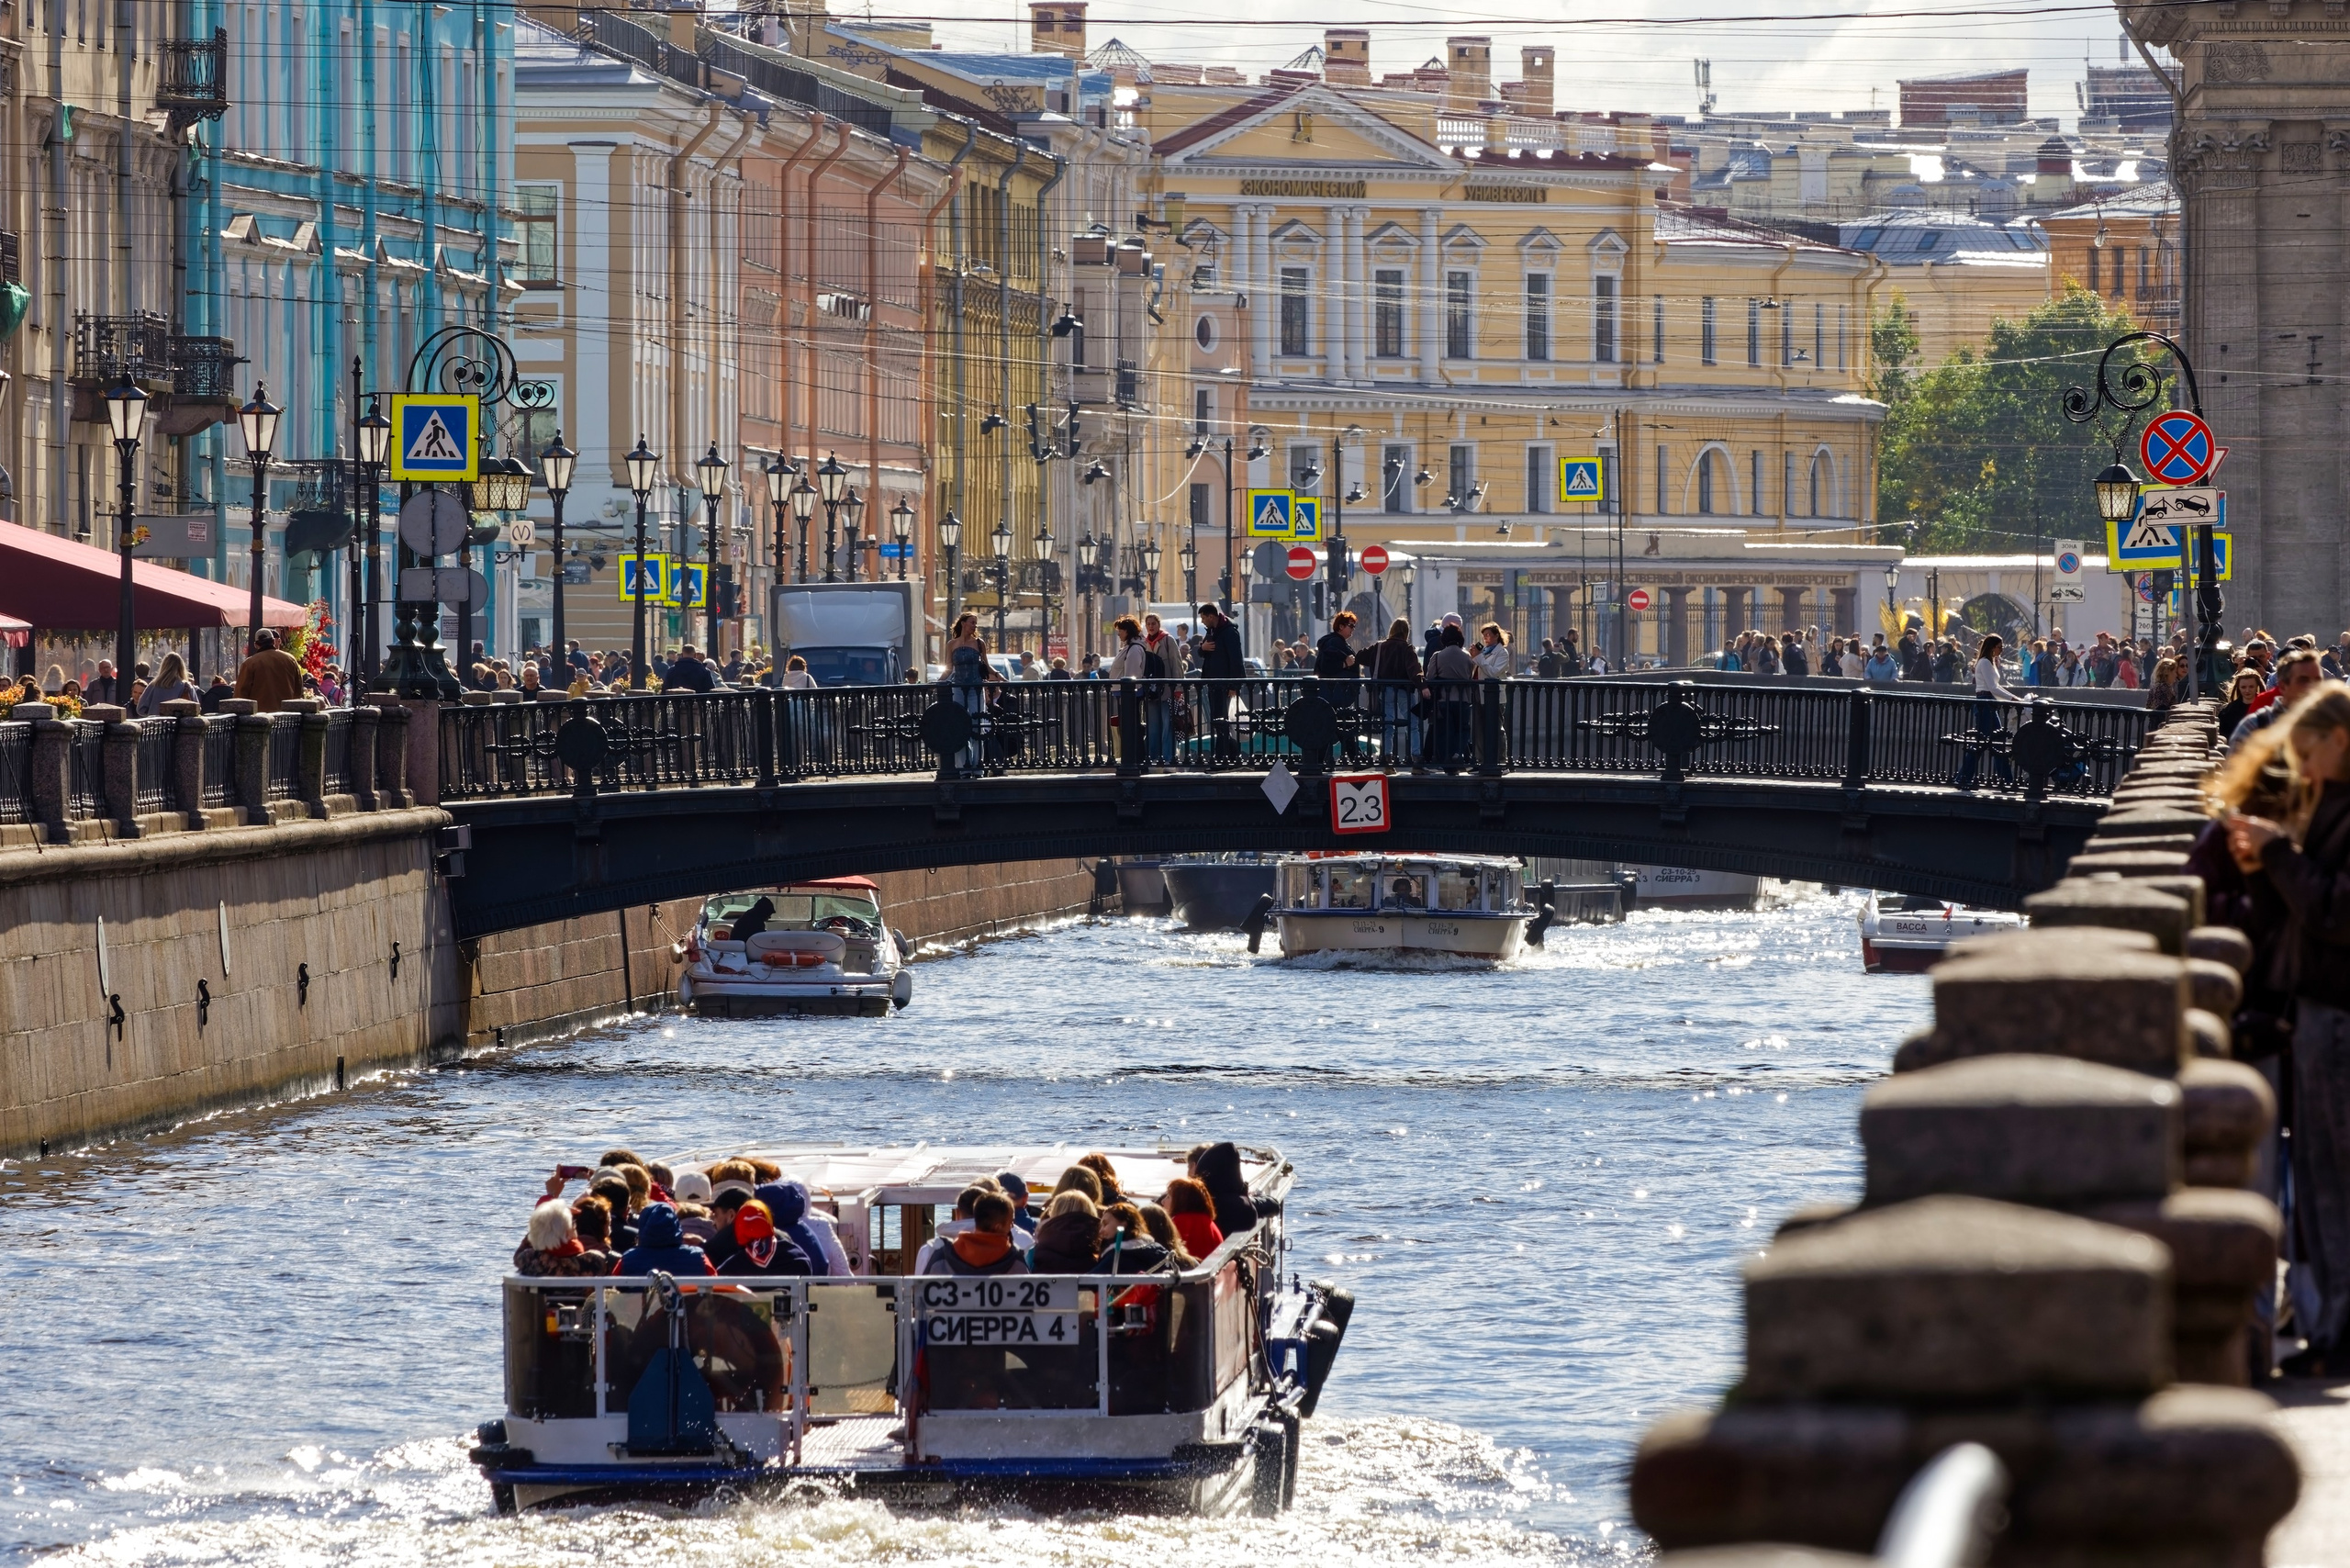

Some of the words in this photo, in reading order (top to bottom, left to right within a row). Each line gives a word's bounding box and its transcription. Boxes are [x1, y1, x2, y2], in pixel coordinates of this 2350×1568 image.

[1242, 180, 1367, 198] ЭКОНОМИЧЕСКИЙ
[1464, 185, 1549, 203] УНИВЕРСИТЕТ
[1684, 572, 1774, 586] ЭКОНОМИЧЕСКИЙ
[1775, 574, 1848, 586] УНИВЕРСИТЕТ
[1340, 795, 1382, 823] 2.3
[1655, 875, 1693, 883] СИЕРРА
[1695, 875, 1700, 883] 3
[1897, 922, 1927, 931] ВАССА
[923, 1281, 1050, 1307] СЗ-10-26
[928, 1316, 1039, 1342] СИЕРРА
[1048, 1316, 1066, 1341] 4
